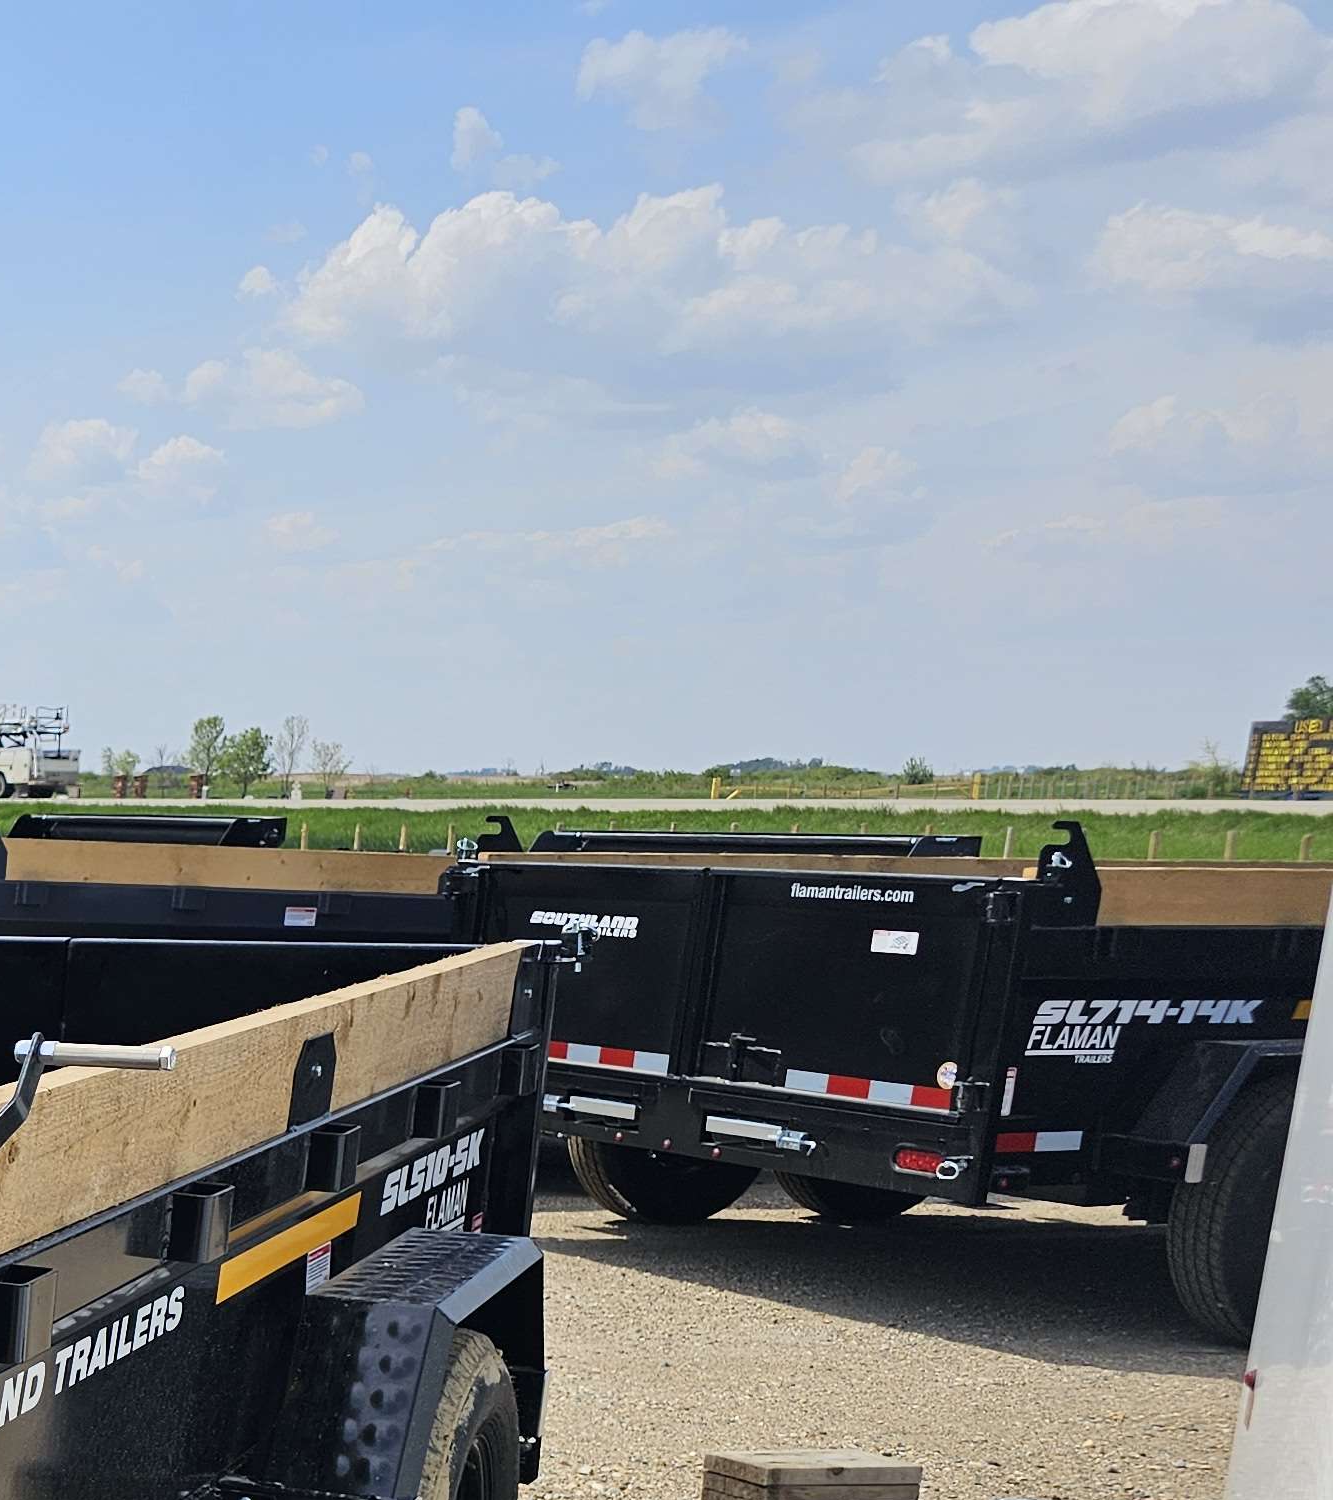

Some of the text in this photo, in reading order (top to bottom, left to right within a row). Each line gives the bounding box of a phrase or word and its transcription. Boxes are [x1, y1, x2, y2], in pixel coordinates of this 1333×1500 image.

[790, 883, 915, 903] flamantrailers.com
[530, 911, 639, 929] SOUTHLAND
[1033, 1000, 1265, 1024] SL714-14K
[1027, 1026, 1120, 1049] FLAMAN
[1074, 1054, 1112, 1064] TRAILERS
[380, 1128, 485, 1216] SL510-5K
[425, 1178, 470, 1230] FLAMAN
[54, 1285, 185, 1396] TRAILERS
